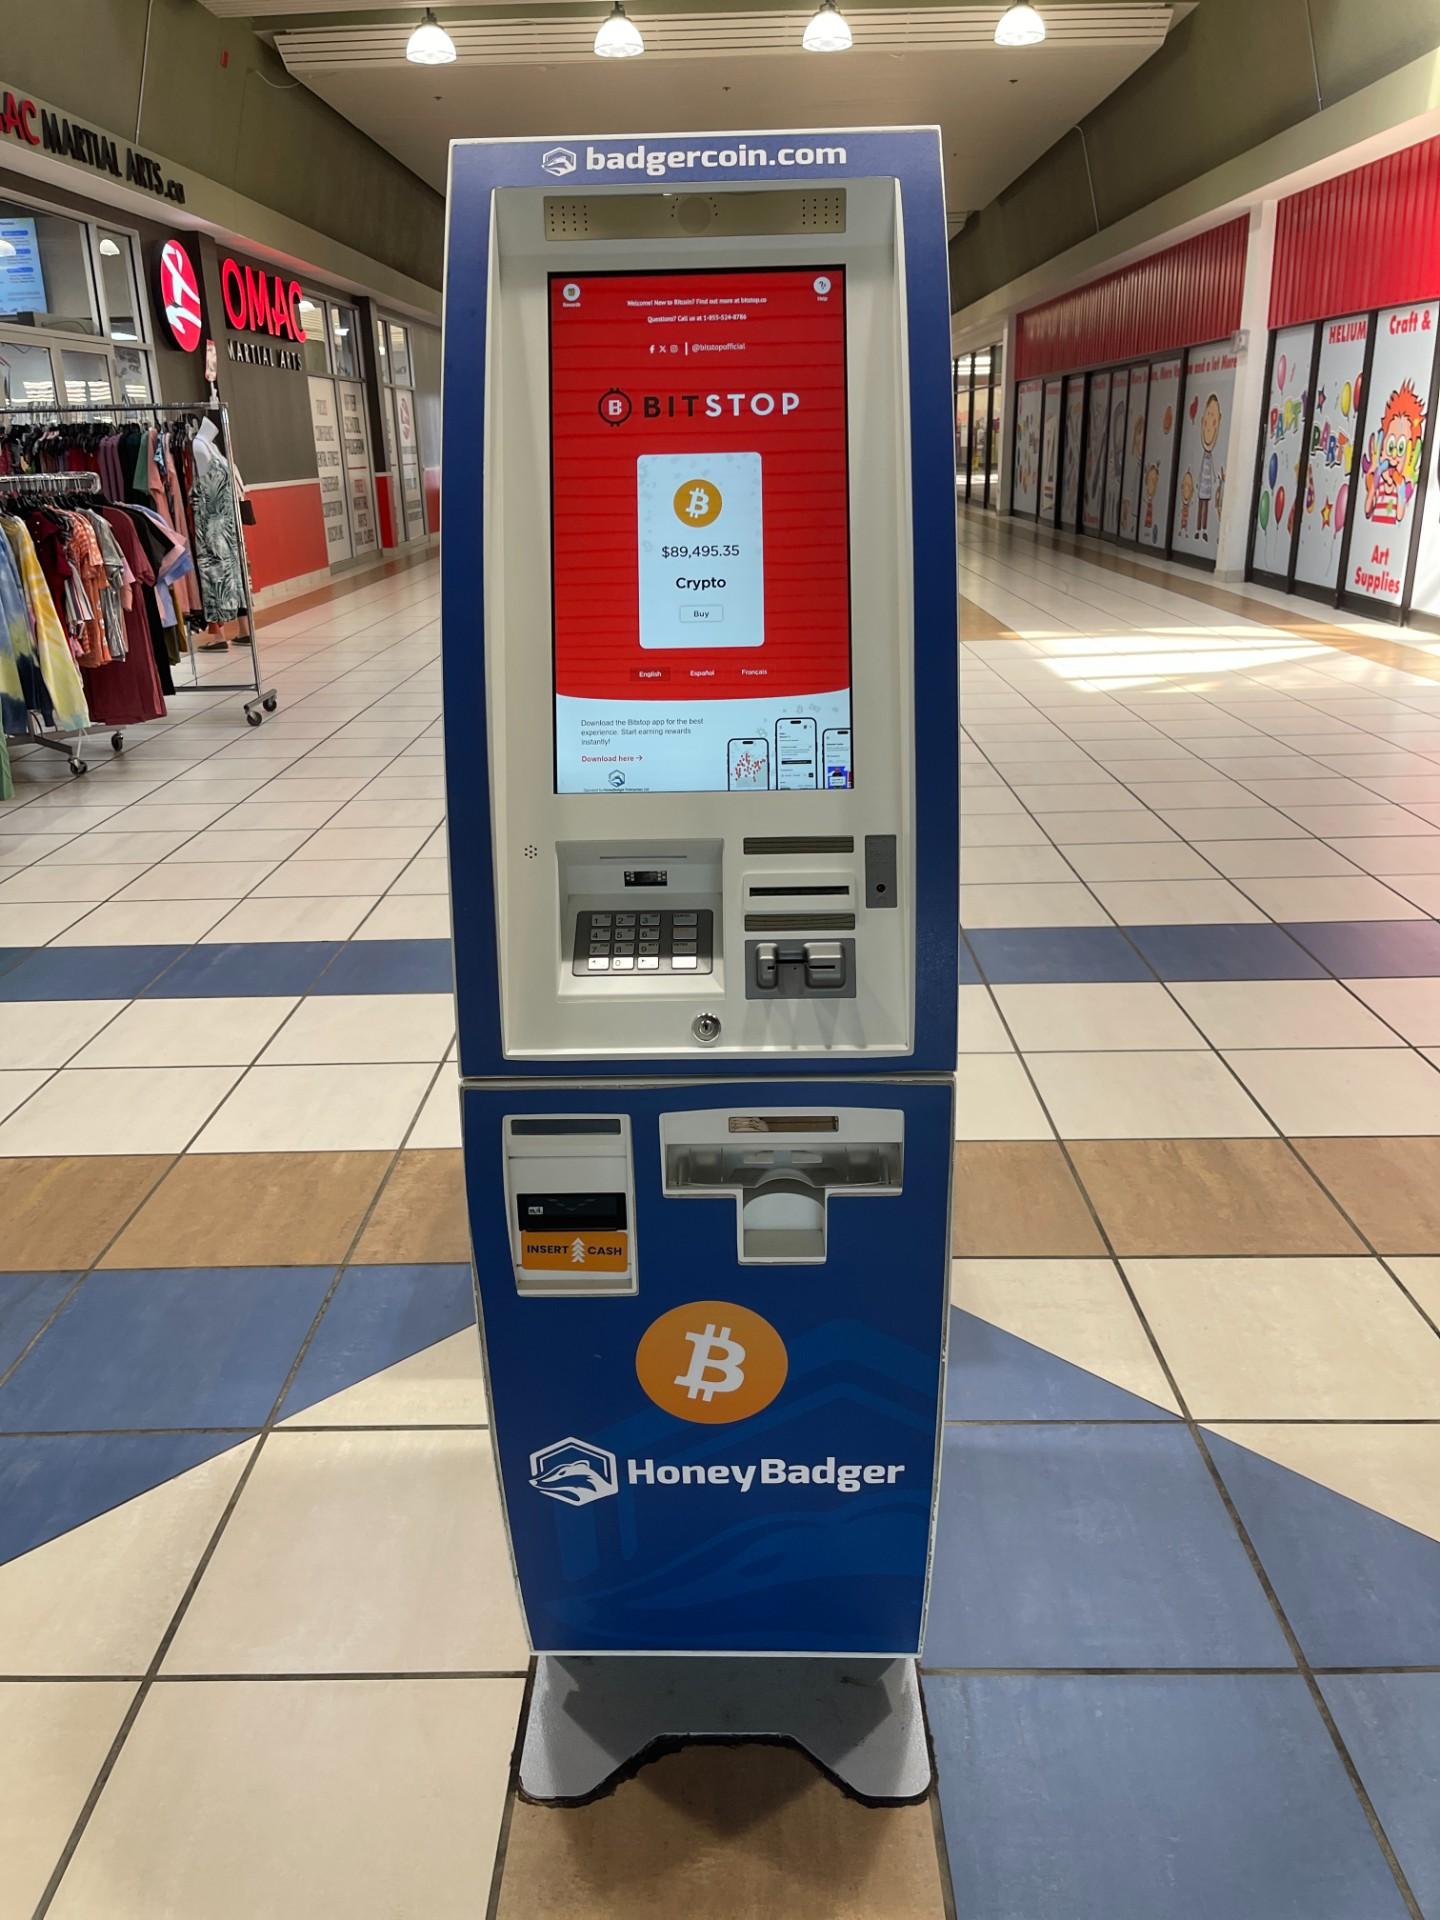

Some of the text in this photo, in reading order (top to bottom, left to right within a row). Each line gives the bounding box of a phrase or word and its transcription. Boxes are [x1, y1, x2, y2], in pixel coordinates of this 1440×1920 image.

[0, 91, 40, 145] AC
[41, 108, 122, 177] MARTIAL
[586, 144, 847, 176] badgercoin.com
[222, 258, 308, 343] OMAC
[648, 315, 677, 323] Questions?
[1389, 309, 1431, 335] Craft &
[1329, 320, 1367, 345] HELIUM
[227, 339, 303, 371] MARTIAL ARTS
[692, 342, 746, 353] @bitstopofficial
[1221, 353, 1238, 370] More
[643, 392, 800, 418] BITSTOP
[661, 544, 740, 559] $89,495.35
[1371, 544, 1390, 566] Art
[675, 576, 727, 591] Crypto
[1354, 566, 1401, 594] Supplies
[693, 609, 709, 619] Buy
[689, 669, 715, 678] Español
[581, 719, 614, 727] Download
[627, 718, 650, 727] Bitstop
[652, 719, 665, 727] app
[688, 717, 703, 725] best
[580, 729, 619, 737] experience.
[581, 738, 611, 747] instantly!
[527, 1244, 622, 1256] INSERT CASH
[627, 1456, 906, 1493] HoneyBadger
